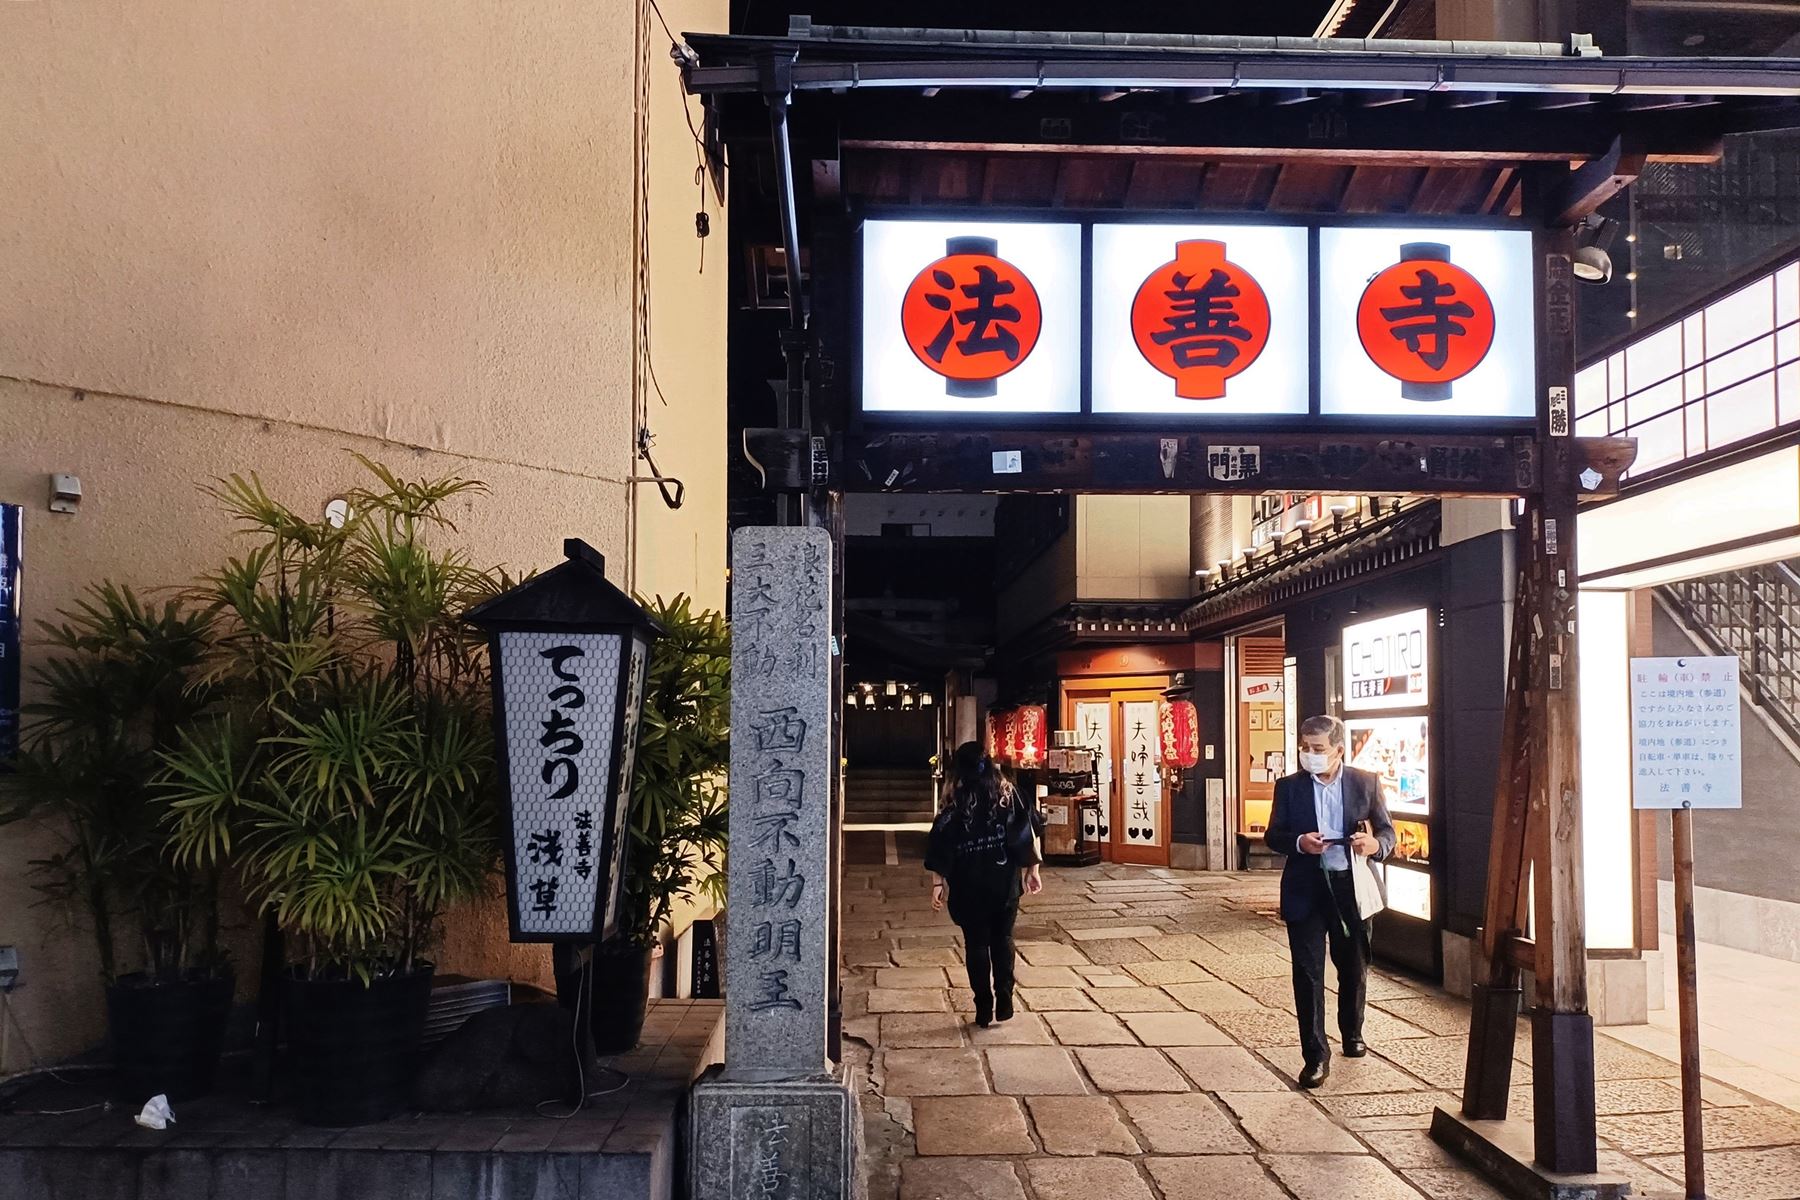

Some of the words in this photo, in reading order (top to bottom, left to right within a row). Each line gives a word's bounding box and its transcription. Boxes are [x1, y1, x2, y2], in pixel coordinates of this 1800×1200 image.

[923, 265, 1021, 363] 法
[1150, 268, 1253, 369] 善
[1379, 269, 1475, 371] 寺
[736, 542, 780, 679] 三大不動
[539, 645, 586, 799] てっちり
[1130, 715, 1151, 822] 夫婦善哉
[573, 810, 594, 880] 法善寺
[747, 705, 808, 1011] 西向不動明王
